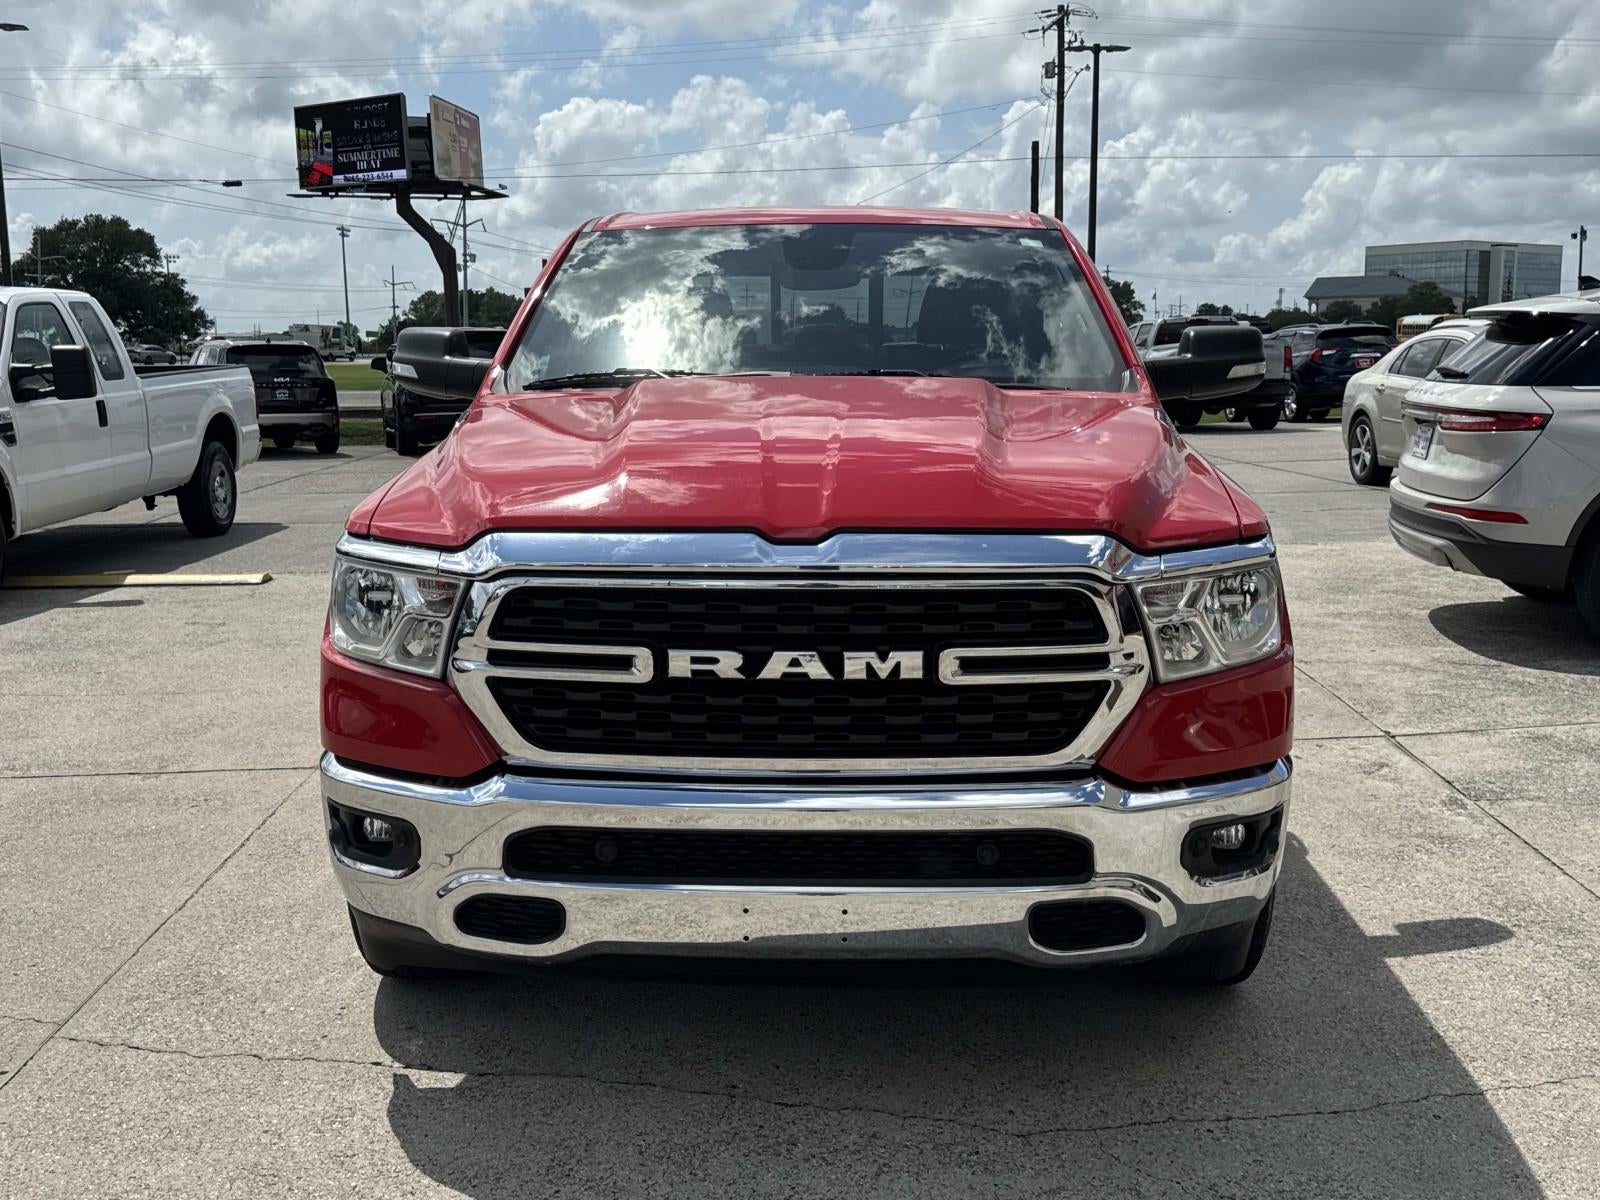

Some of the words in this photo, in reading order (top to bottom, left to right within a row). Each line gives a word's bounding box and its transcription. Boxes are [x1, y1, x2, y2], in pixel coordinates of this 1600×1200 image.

[337, 147, 400, 163] SUMMERTIME
[356, 159, 381, 170] HEAT
[667, 649, 924, 680] RAM
